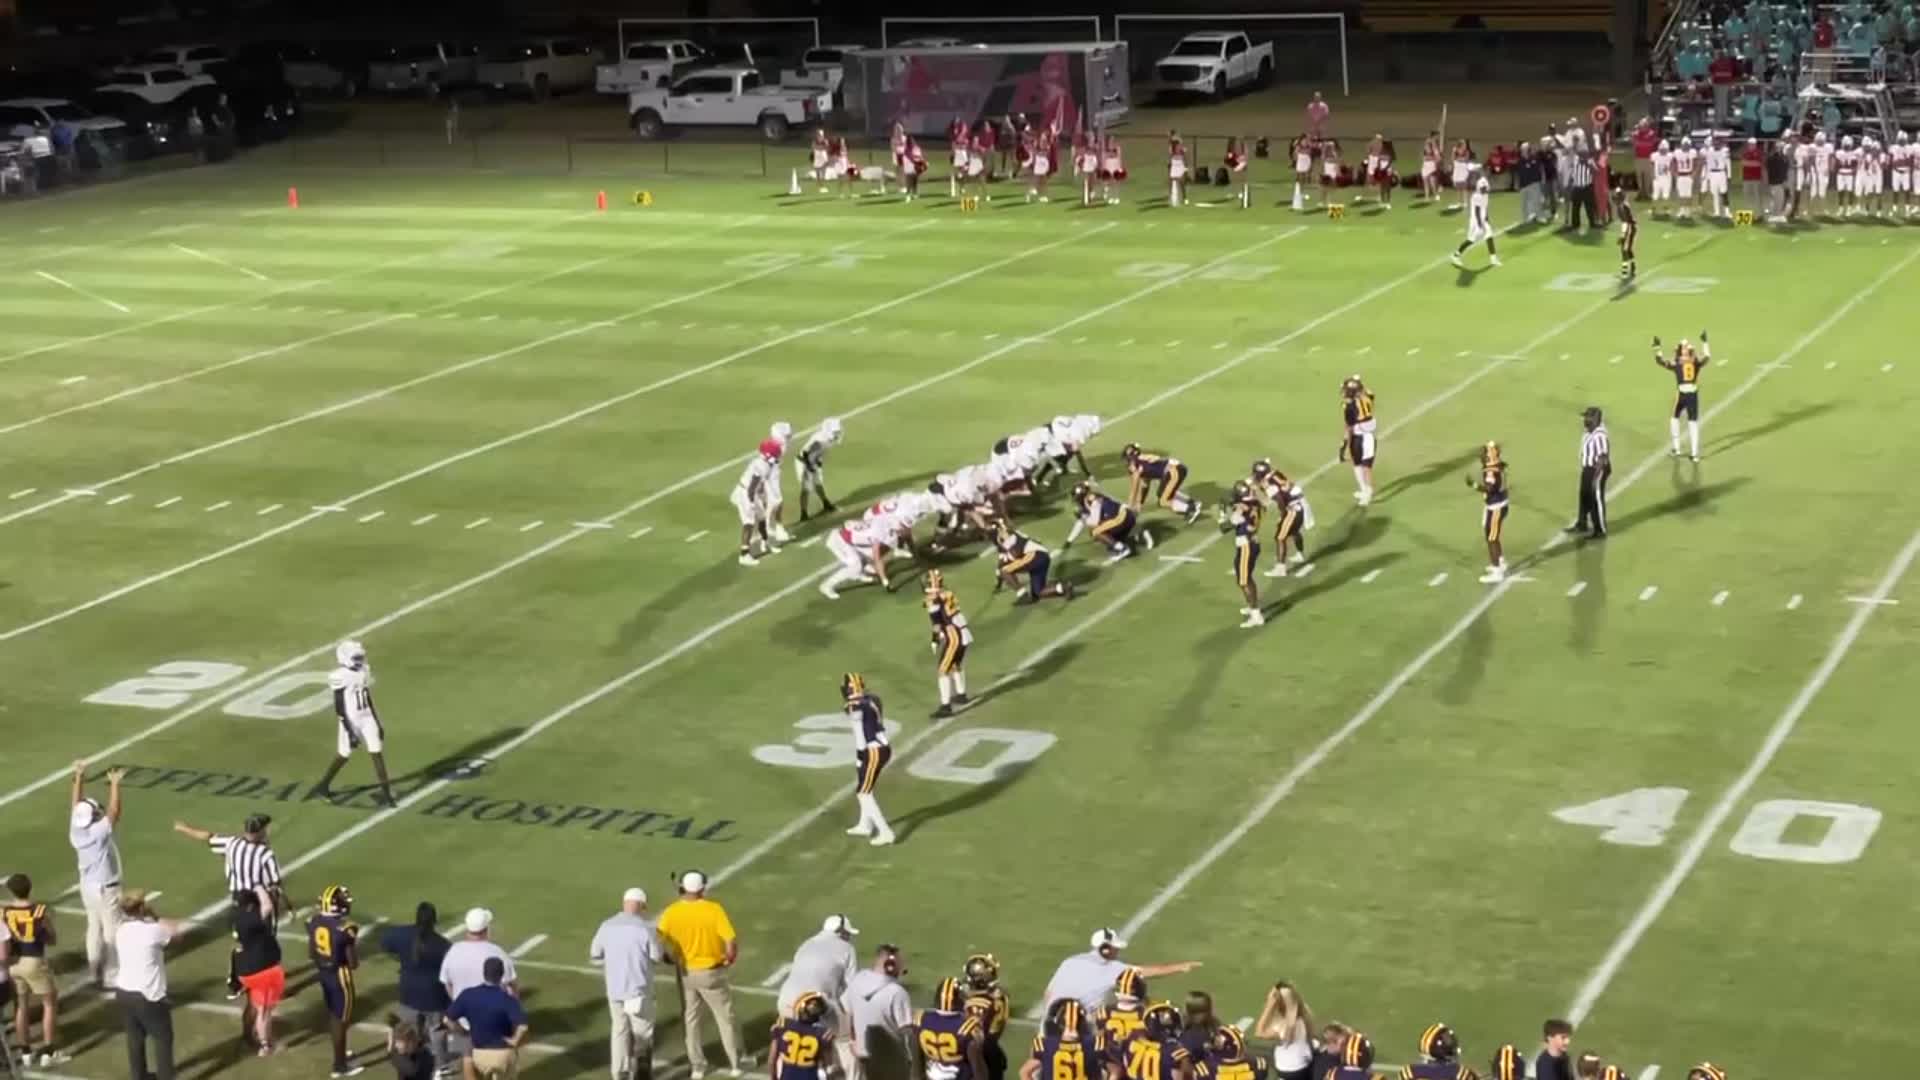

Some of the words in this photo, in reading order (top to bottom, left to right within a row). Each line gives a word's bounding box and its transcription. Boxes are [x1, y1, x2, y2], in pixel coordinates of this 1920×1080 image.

[751, 712, 1059, 784] 30
[420, 794, 738, 843] HOSPITAL
[1550, 786, 1882, 863] 40
[314, 926, 331, 957] 9
[782, 1030, 819, 1067] 32
[919, 1029, 962, 1062] 62
[1053, 1049, 1084, 1080] 61
[1128, 1038, 1161, 1080] 70
